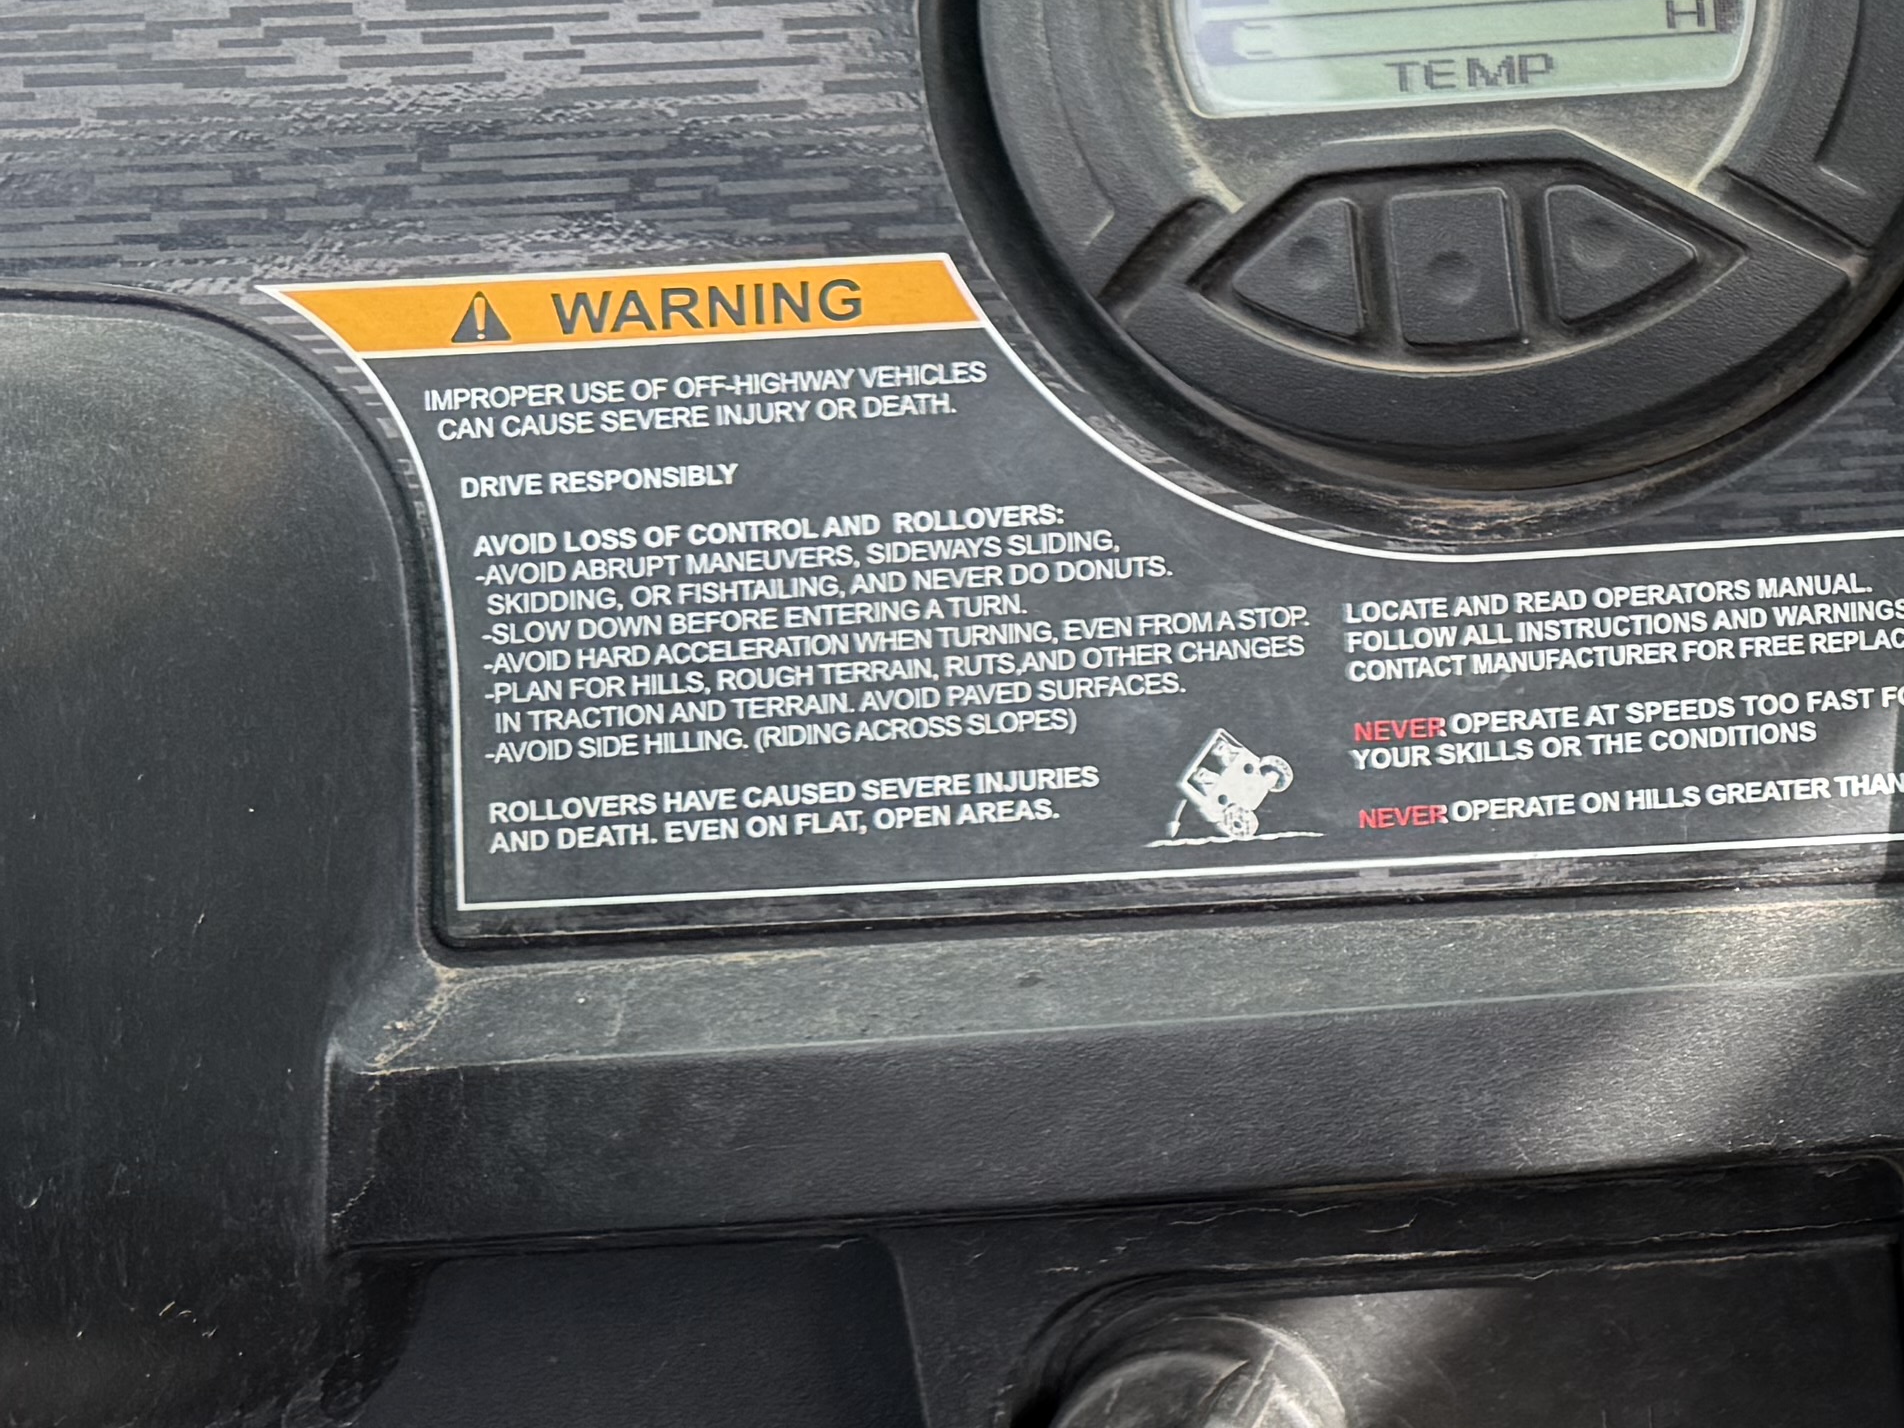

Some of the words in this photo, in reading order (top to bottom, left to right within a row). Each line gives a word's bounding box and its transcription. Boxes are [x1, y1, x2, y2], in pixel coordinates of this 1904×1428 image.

[1384, 52, 1556, 92] TEMP
[551, 278, 863, 335] WARNING
[424, 383, 566, 411] IMPROPER
[570, 380, 626, 405] USE
[630, 377, 669, 401] OF
[673, 368, 855, 399] OFF-HIGHWAY
[858, 361, 988, 389] VEHICLES
[437, 416, 494, 441] CAN
[500, 411, 595, 438] CAUSE
[599, 405, 710, 433] SEVERE
[715, 400, 811, 426] INJURY
[815, 397, 858, 421] OR
[862, 392, 957, 418] DEATH.
[460, 473, 543, 498] DRIVE
[549, 463, 739, 495] RESPONSIBLY
[473, 532, 557, 557] AVOID
[563, 526, 638, 553] LOSS
[642, 525, 681, 548] OF
[687, 517, 820, 546] CONTROL
[821, 514, 881, 538] AND
[892, 503, 1065, 534] ROLLOVERS:
[1342, 597, 1449, 624] LOCATE
[1452, 593, 1509, 617] AND
[1513, 589, 1587, 613] READ
[1592, 579, 1751, 609] OPERATORS
[1756, 573, 1873, 599] MANUAL.
[1343, 626, 1458, 653] FOLLOW
[1460, 622, 1514, 646] ALL
[1516, 610, 1708, 643] INSTRUCTIONS
[1711, 607, 1768, 631] AND
[1347, 654, 1467, 682] CONTACT
[1469, 642, 1678, 675] MANUFACTURER
[1681, 638, 1736, 662] FOR
[1738, 634, 1806, 659] FREE
[1353, 717, 1448, 742] NEVER
[1450, 706, 1580, 735] OPERATE
[1583, 703, 1620, 727] AT
[1625, 696, 1736, 724] SPEEDS
[1739, 692, 1800, 717] TOO
[1806, 688, 1875, 713] FAST
[1349, 745, 1432, 771] YOUR
[1435, 738, 1534, 765] SKILLS
[1539, 735, 1583, 759] OR
[1585, 731, 1643, 756] THE
[1648, 720, 1817, 752] CONDITIONS
[488, 793, 658, 824] ROLLOVERS
[663, 788, 738, 814] HAVE
[741, 781, 856, 809] CAUSED
[861, 773, 971, 801] SEVERE
[975, 765, 1100, 794] INJURIES
[1358, 804, 1449, 829] NEVER
[1450, 793, 1576, 822] OPERATE
[1579, 791, 1621, 813] ON
[1624, 785, 1702, 811] HILLS
[1705, 777, 1832, 806] GREATER
[489, 829, 550, 854] AND
[556, 822, 658, 849] DEATH.
[664, 817, 739, 843] EVEN
[745, 814, 788, 838] ON
[793, 809, 867, 835] FLAT,
[873, 804, 951, 830] OPEN
[955, 798, 1060, 826] AREAS.
